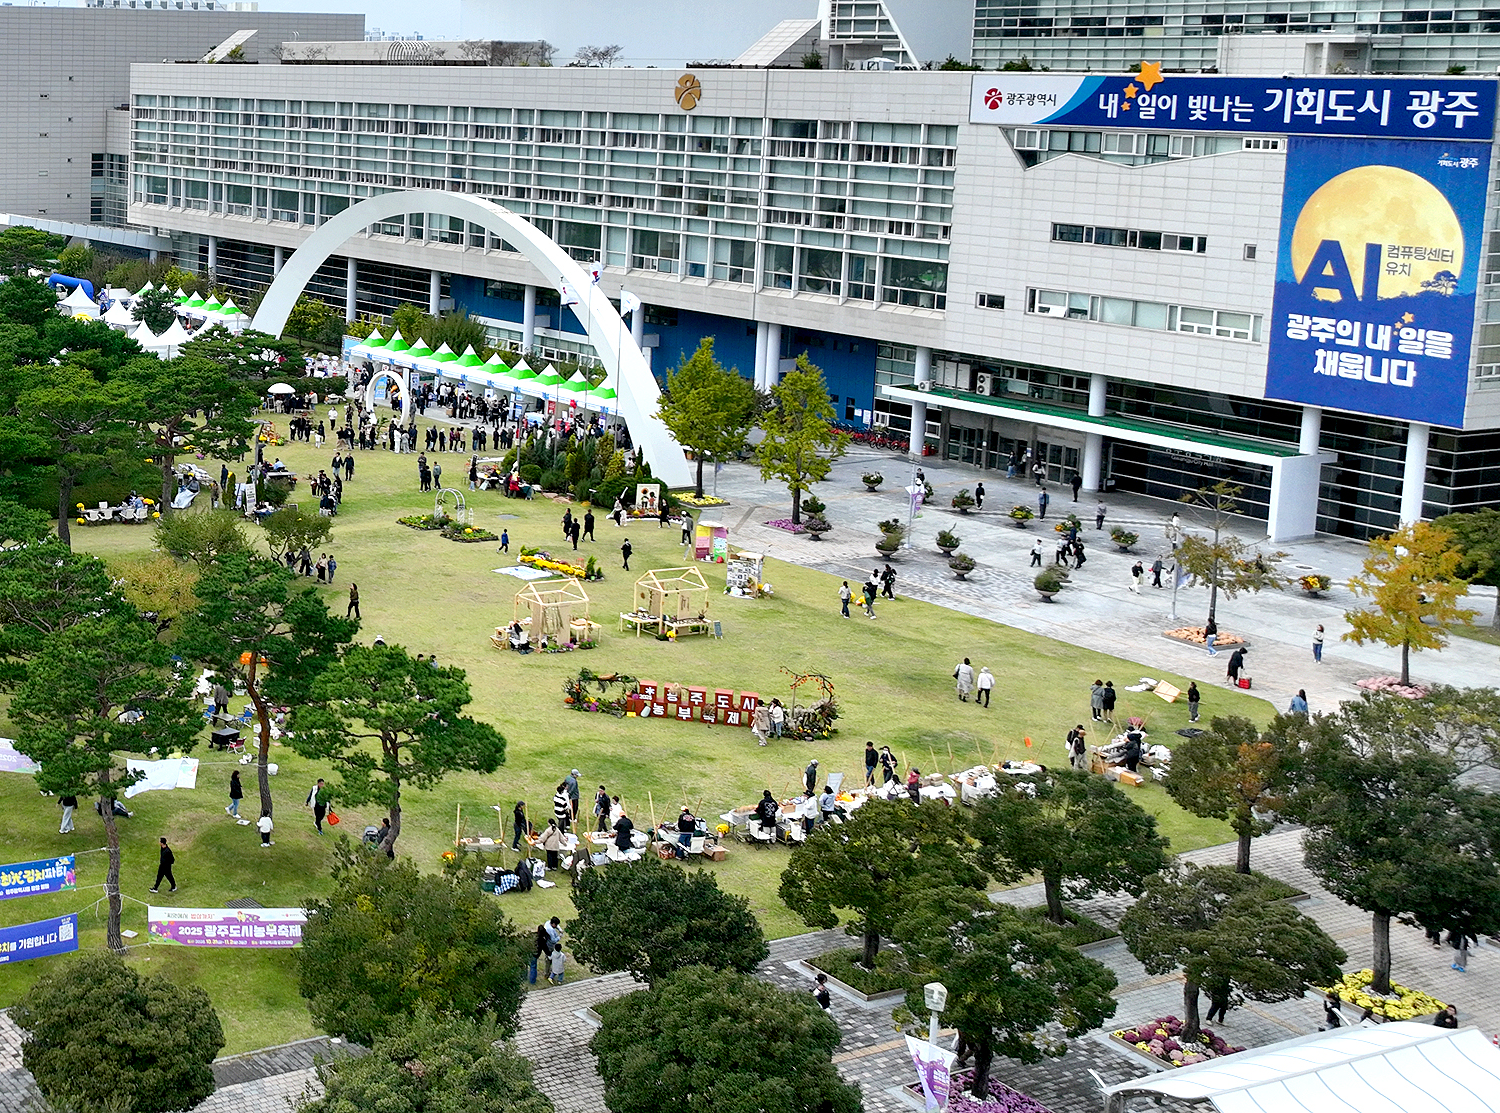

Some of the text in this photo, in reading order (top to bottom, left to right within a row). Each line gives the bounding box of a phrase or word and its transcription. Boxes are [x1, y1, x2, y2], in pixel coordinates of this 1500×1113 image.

[1006, 92, 1057, 107] 광주광역시
[1188, 94, 1255, 123] 빛나는
[1263, 87, 1391, 127] 기회도시
[1406, 89, 1480, 129] 광주
[1460, 157, 1479, 168] 광주
[1386, 244, 1455, 263] 컴퓨팅센터
[1300, 239, 1382, 301] AI
[1384, 261, 1412, 277] 유치
[1286, 313, 1361, 347] 광주의
[1313, 348, 1417, 388] 채웁니다
[178, 924, 301, 938] 2025 광주도시농부축제
[18, 934, 58, 950] 기원합니다
